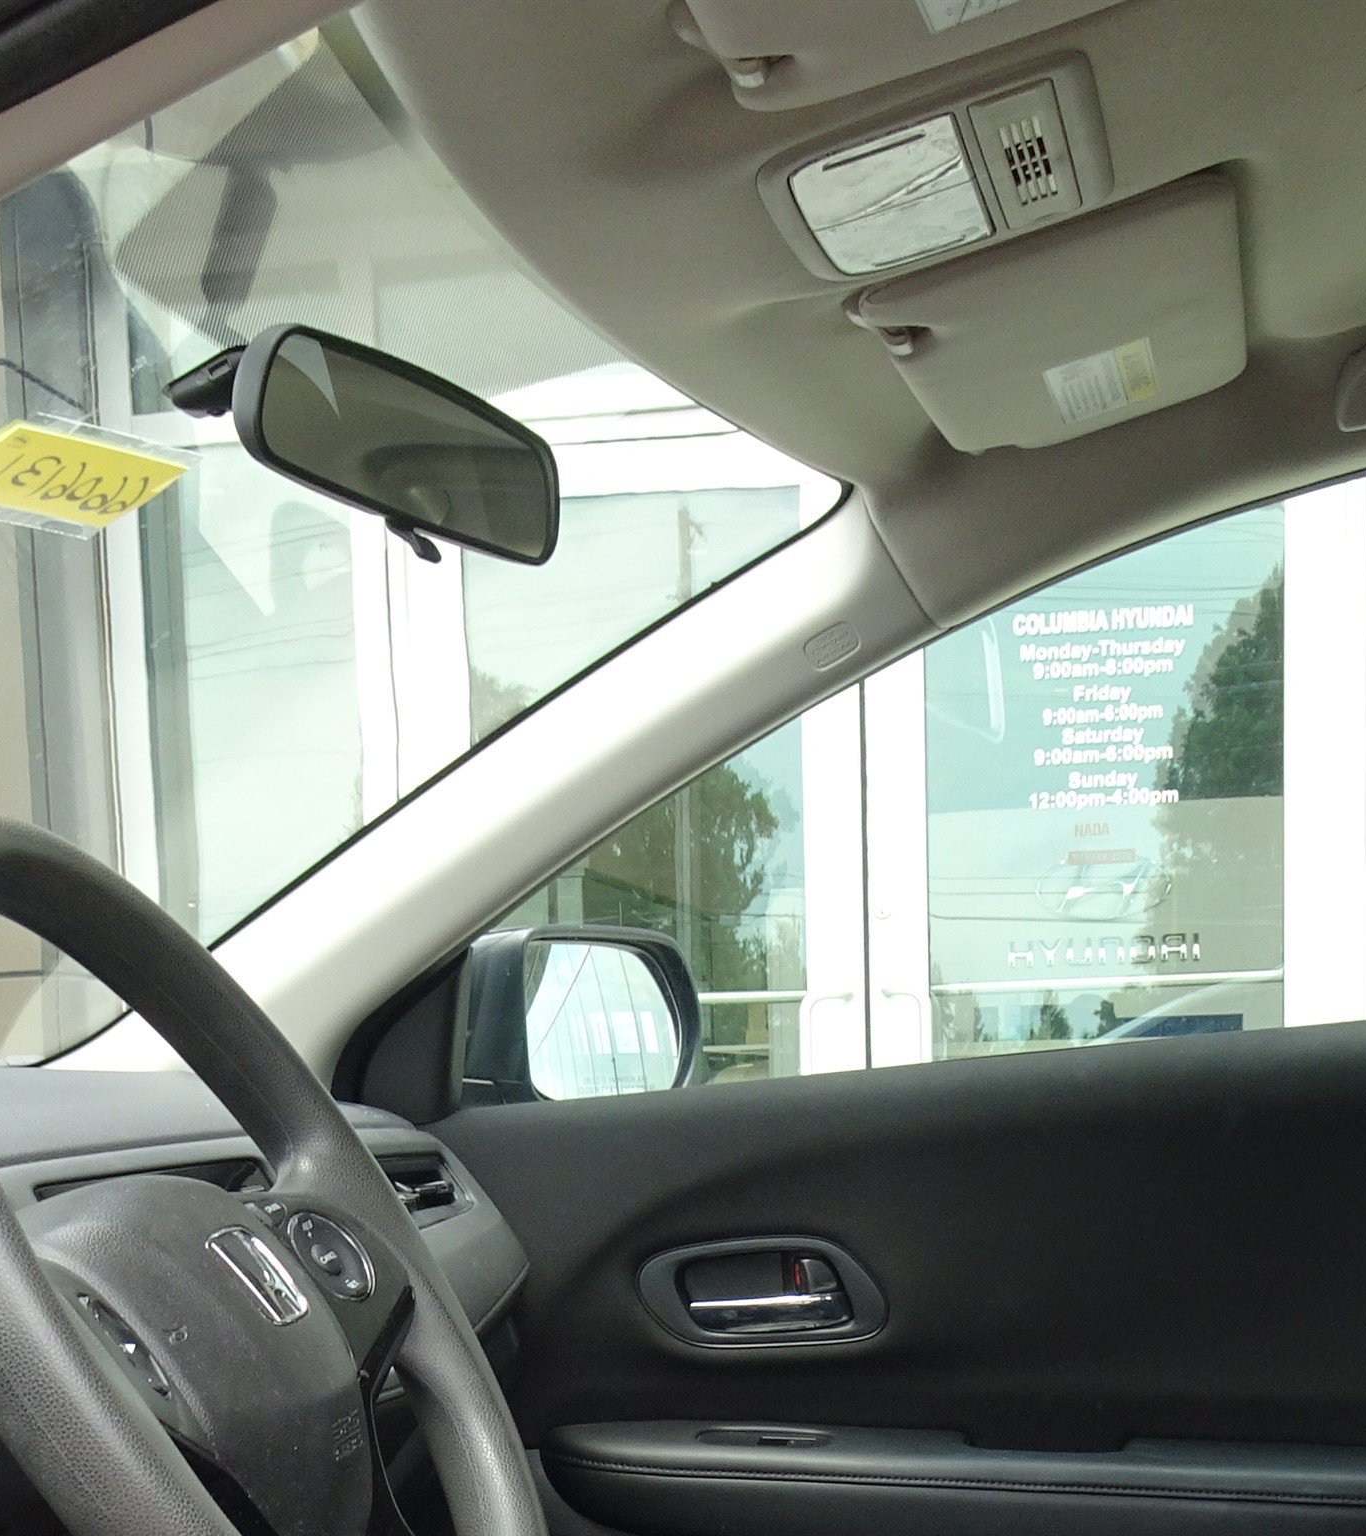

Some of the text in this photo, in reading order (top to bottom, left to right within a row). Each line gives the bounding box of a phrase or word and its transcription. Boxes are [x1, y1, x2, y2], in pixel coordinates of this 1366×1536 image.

[1012, 603, 1194, 636] COLUMBIA HYUNDAI
[1019, 637, 1186, 662] Monday-Thursday
[1073, 684, 1132, 703] Friday
[1061, 725, 1144, 745] Saturday
[1068, 770, 1138, 789] Sunday
[1029, 787, 1179, 810] 12:00pm-4:00pm
[1008, 933, 1201, 968] HYUNDAI
